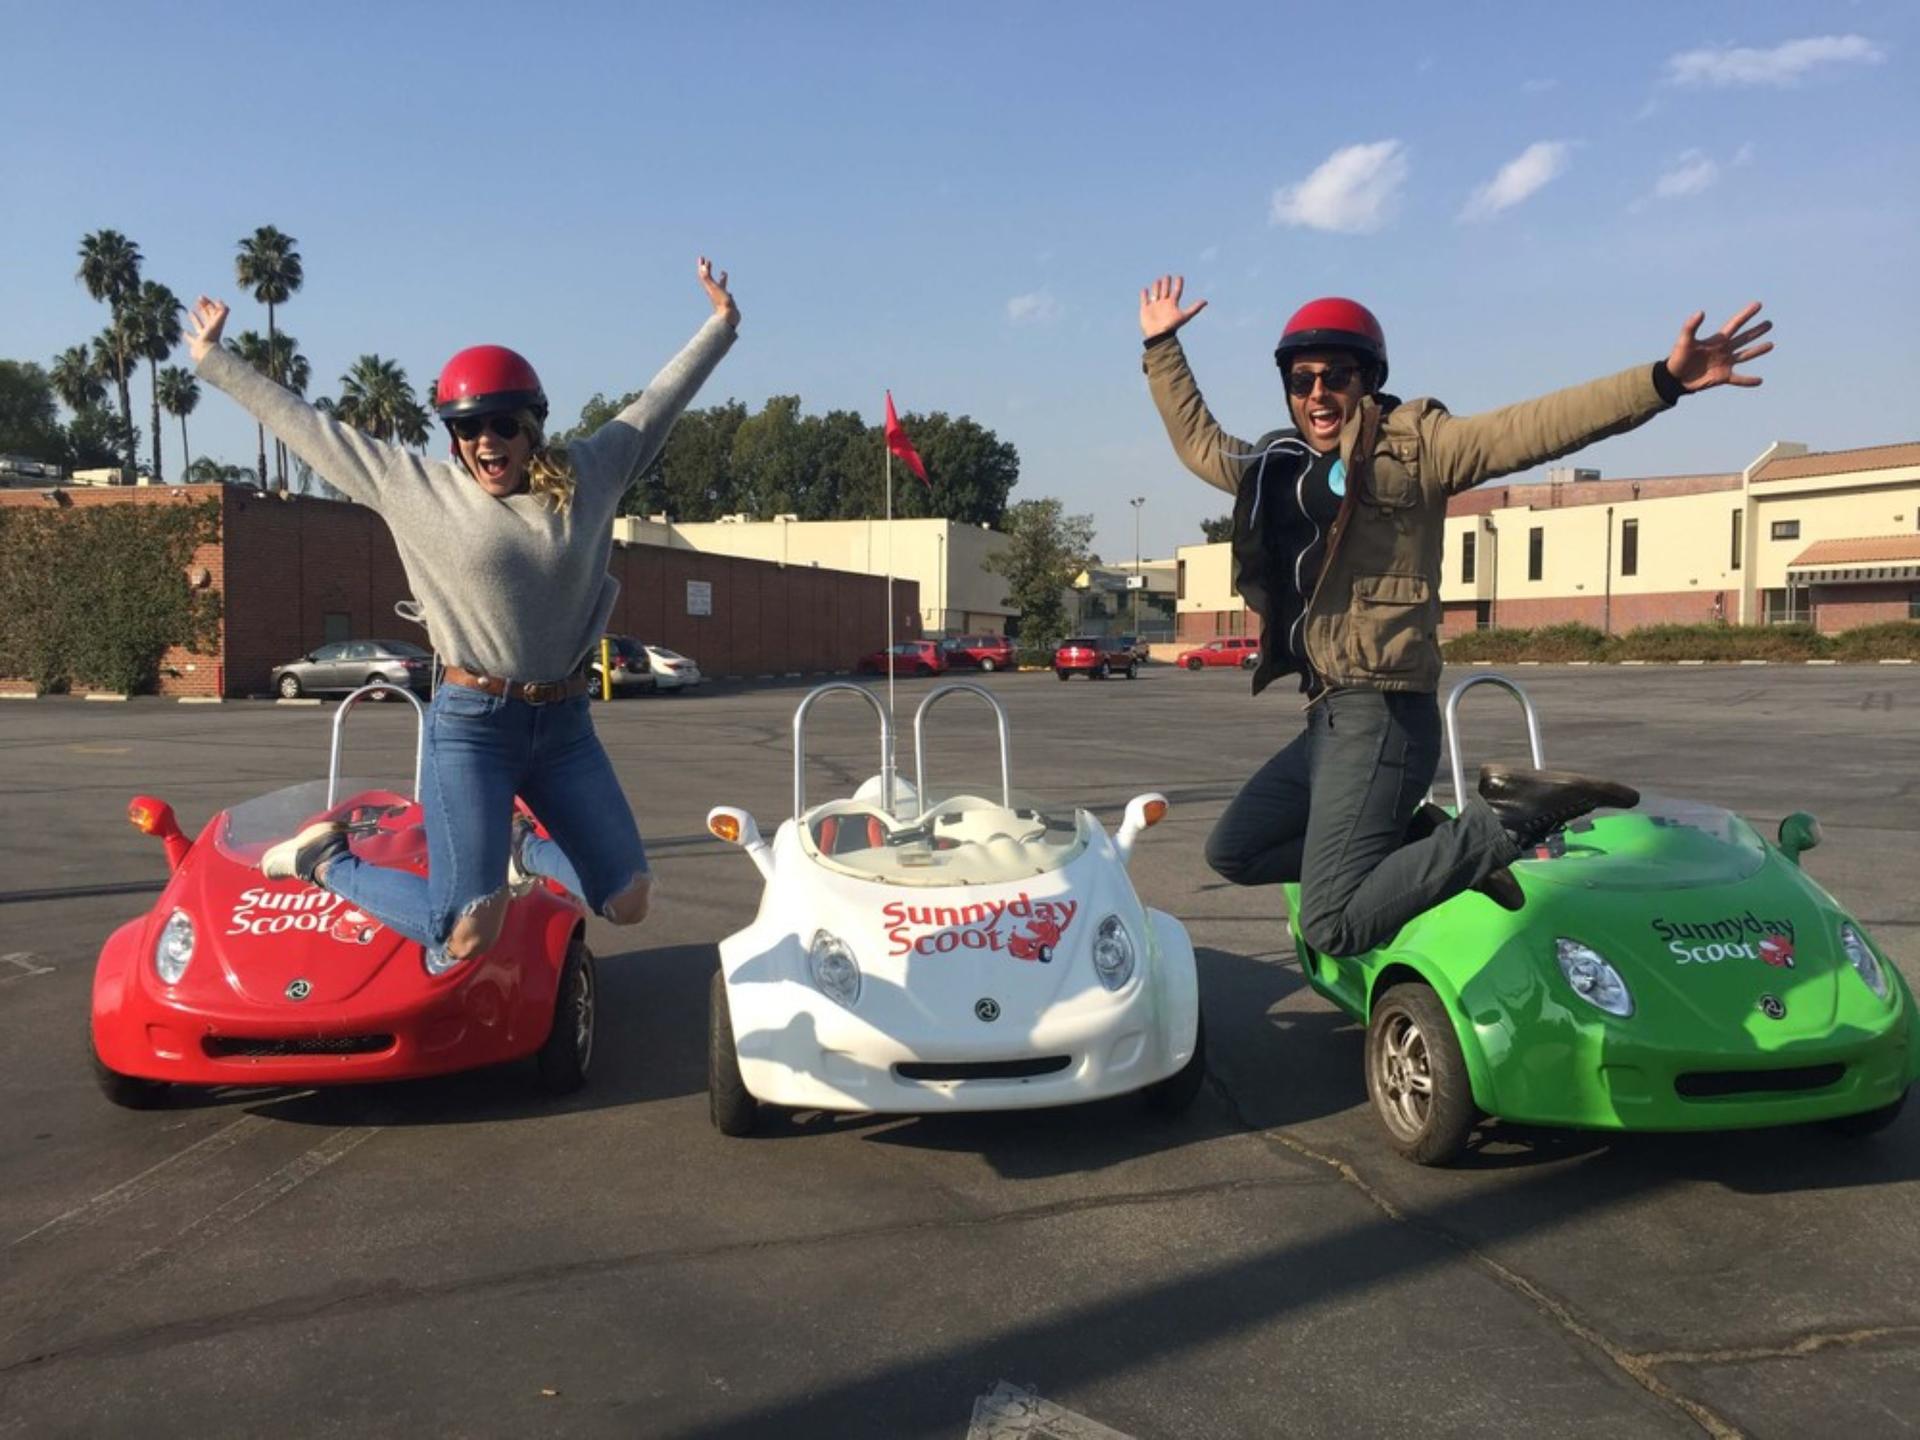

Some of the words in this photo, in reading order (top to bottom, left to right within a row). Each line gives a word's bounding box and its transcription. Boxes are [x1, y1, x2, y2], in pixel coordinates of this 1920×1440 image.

[233, 888, 344, 914] Sunny
[882, 892, 1078, 932] Sunnyday
[226, 911, 334, 935] Scoot
[1652, 911, 1795, 945] Sunnyday
[888, 927, 1004, 956] Scoot
[1670, 941, 1758, 965] Scoot
